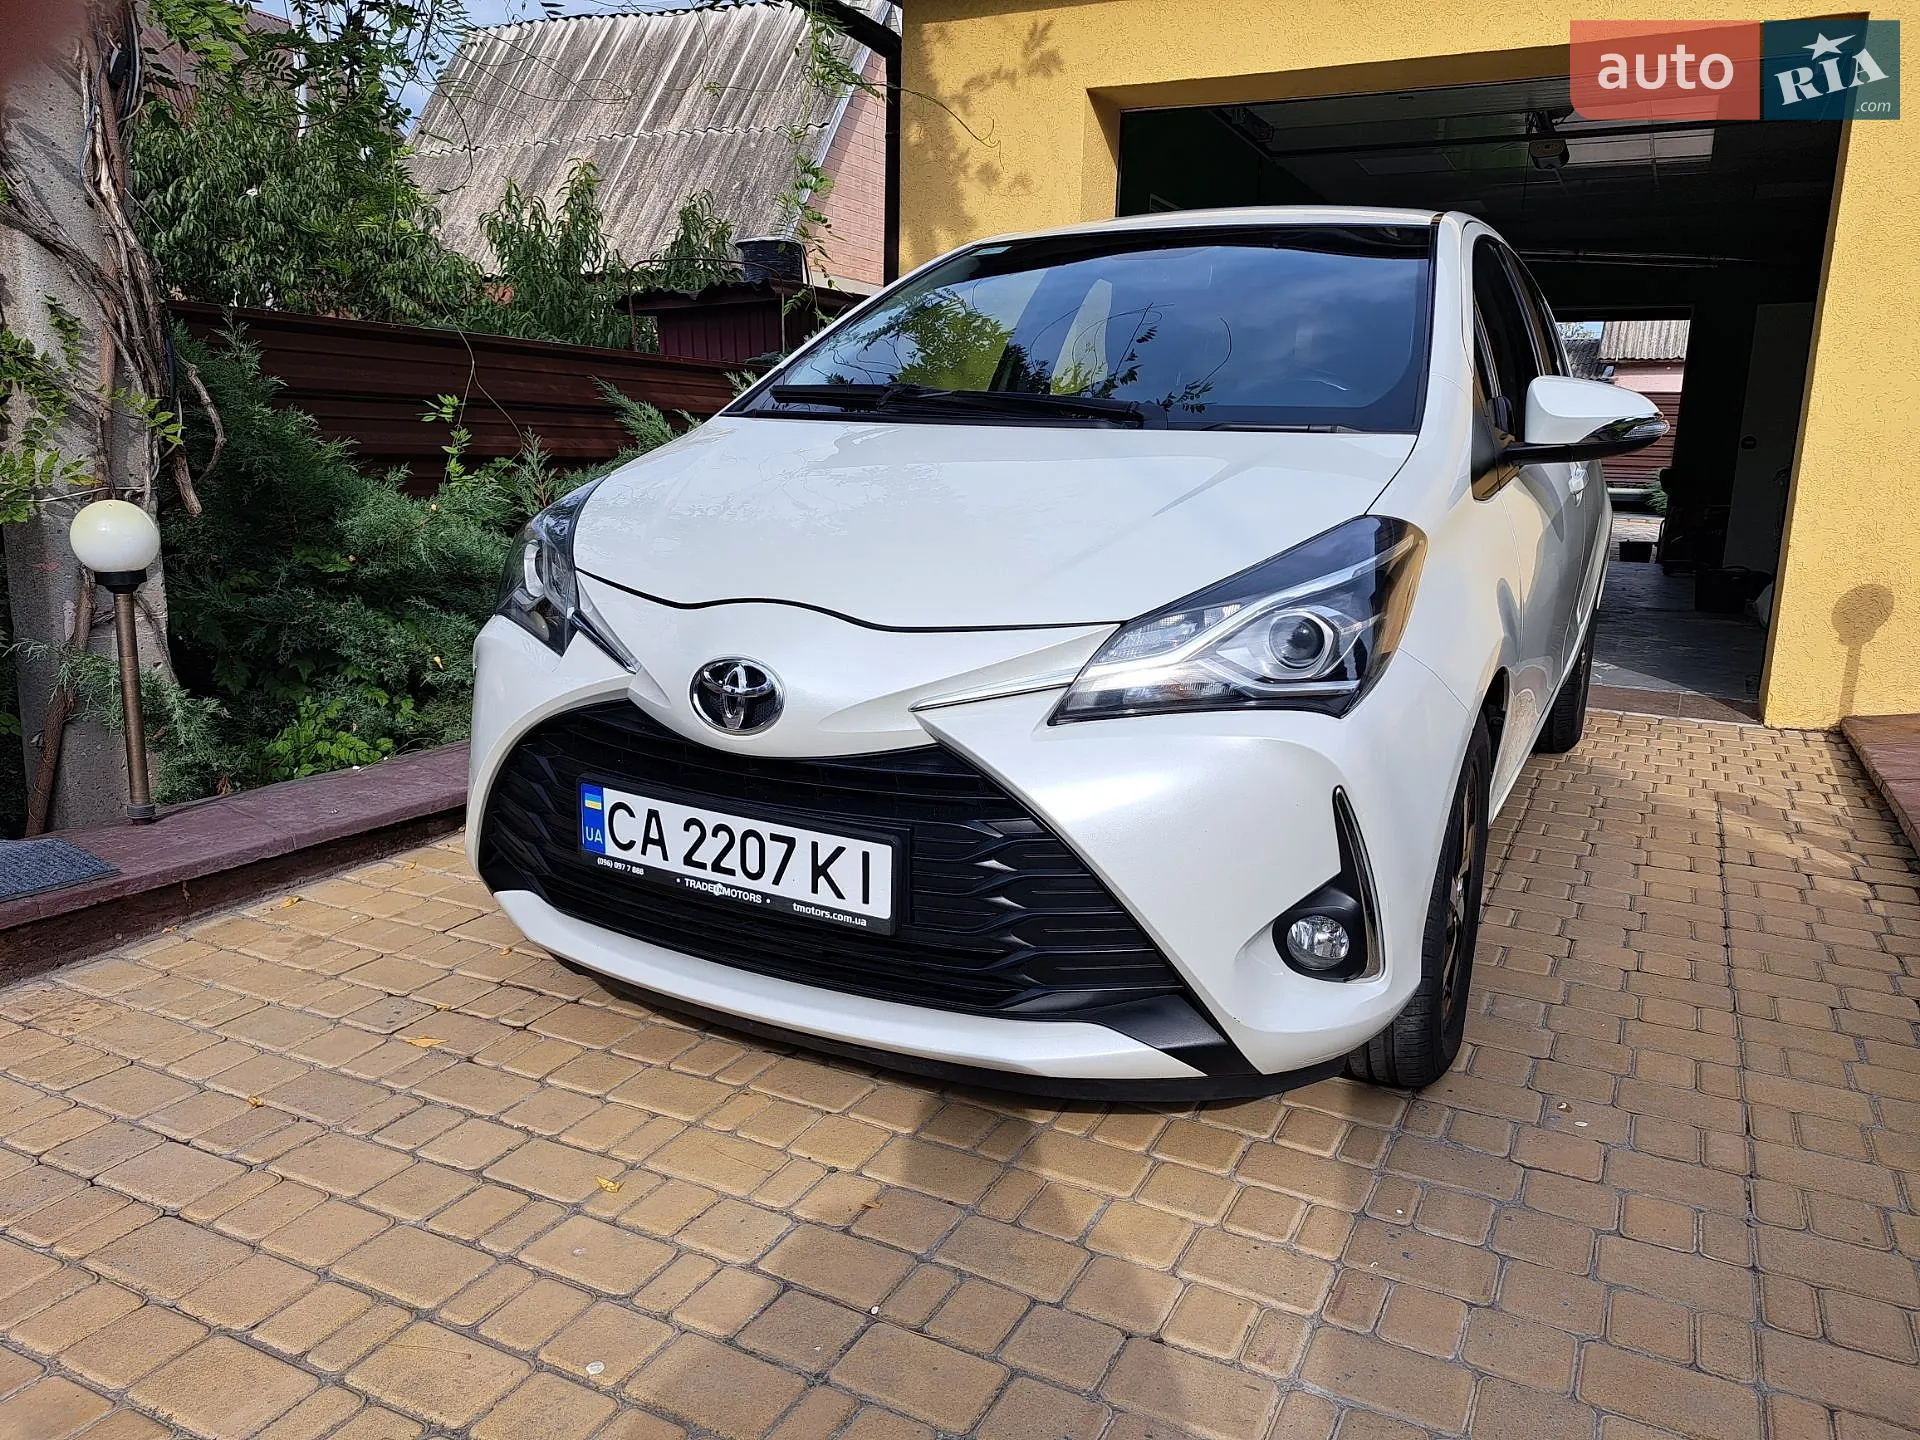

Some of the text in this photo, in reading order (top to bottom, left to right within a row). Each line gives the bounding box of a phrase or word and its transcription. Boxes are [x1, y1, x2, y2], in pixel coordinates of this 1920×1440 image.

[585, 826, 603, 845] UA
[607, 801, 870, 905] CA 2207 KI
[792, 902, 867, 927] tmotors.com.ua
